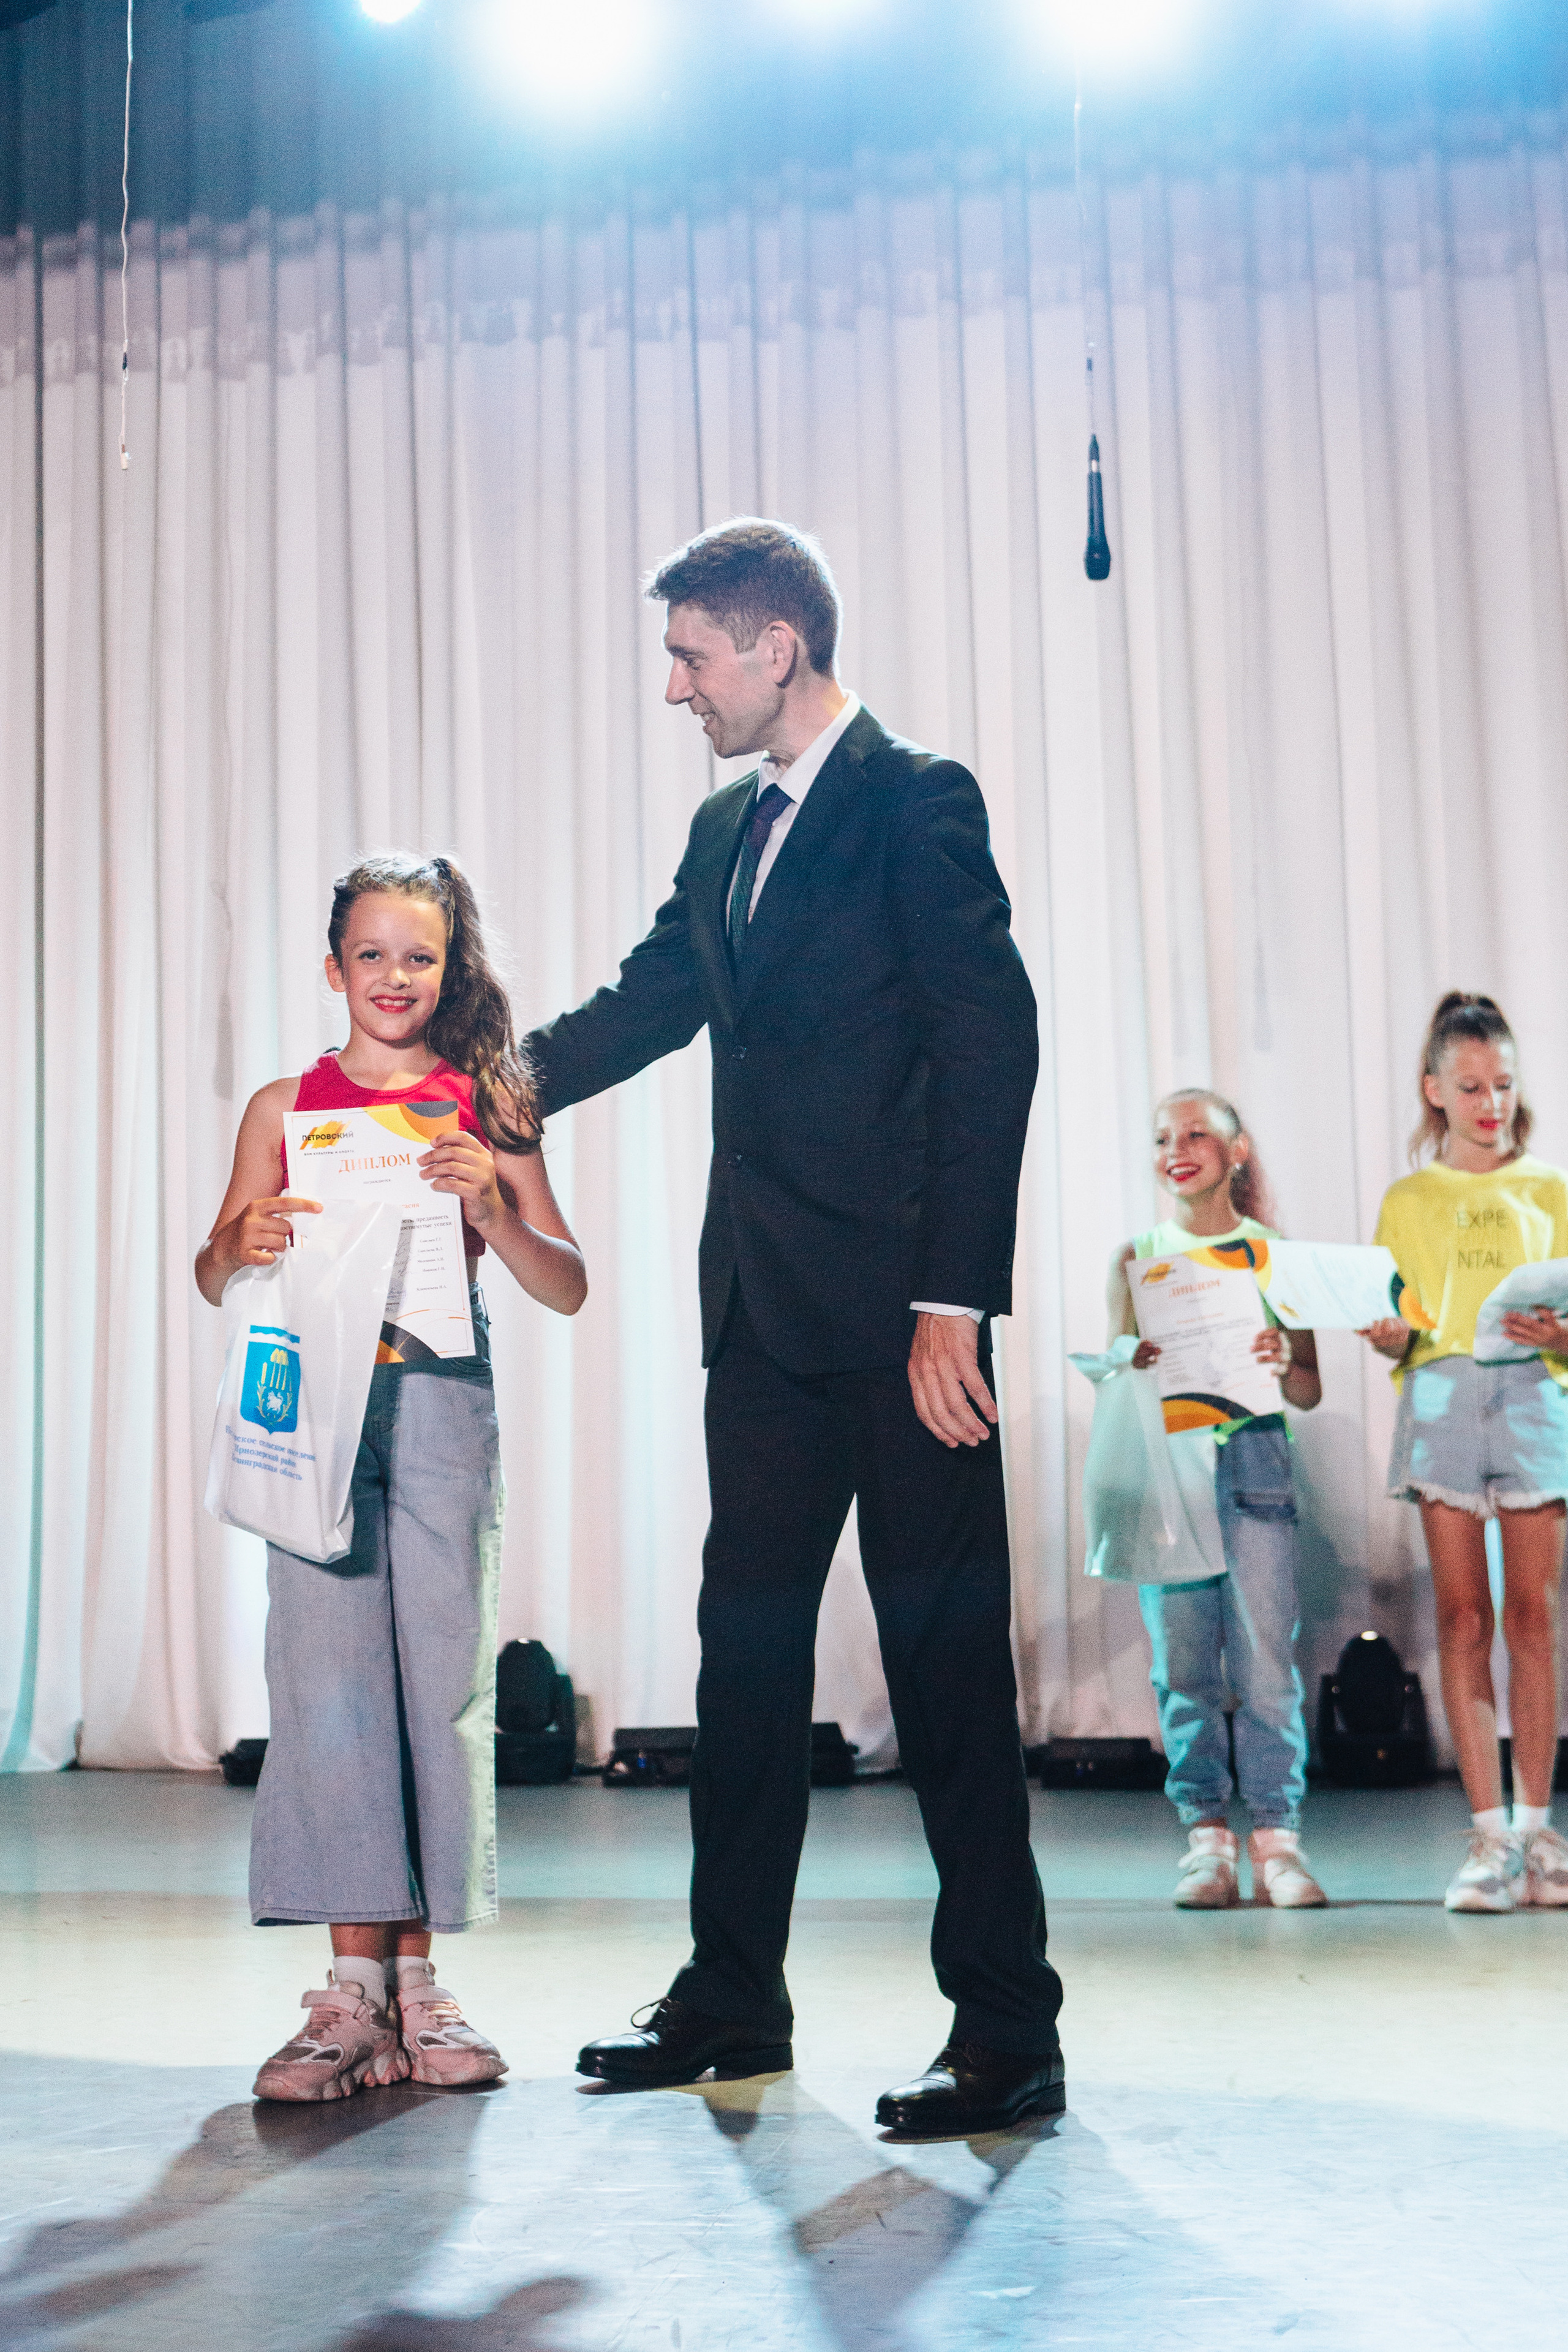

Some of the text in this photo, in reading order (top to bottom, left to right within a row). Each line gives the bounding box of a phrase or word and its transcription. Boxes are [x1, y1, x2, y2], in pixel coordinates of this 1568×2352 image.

[302, 1131, 354, 1141] ПЕТРОВСКИЙ
[339, 1153, 411, 1173] ДИПЛОМ
[1457, 1208, 1507, 1229] EXPE
[1457, 1250, 1506, 1269] NTAL
